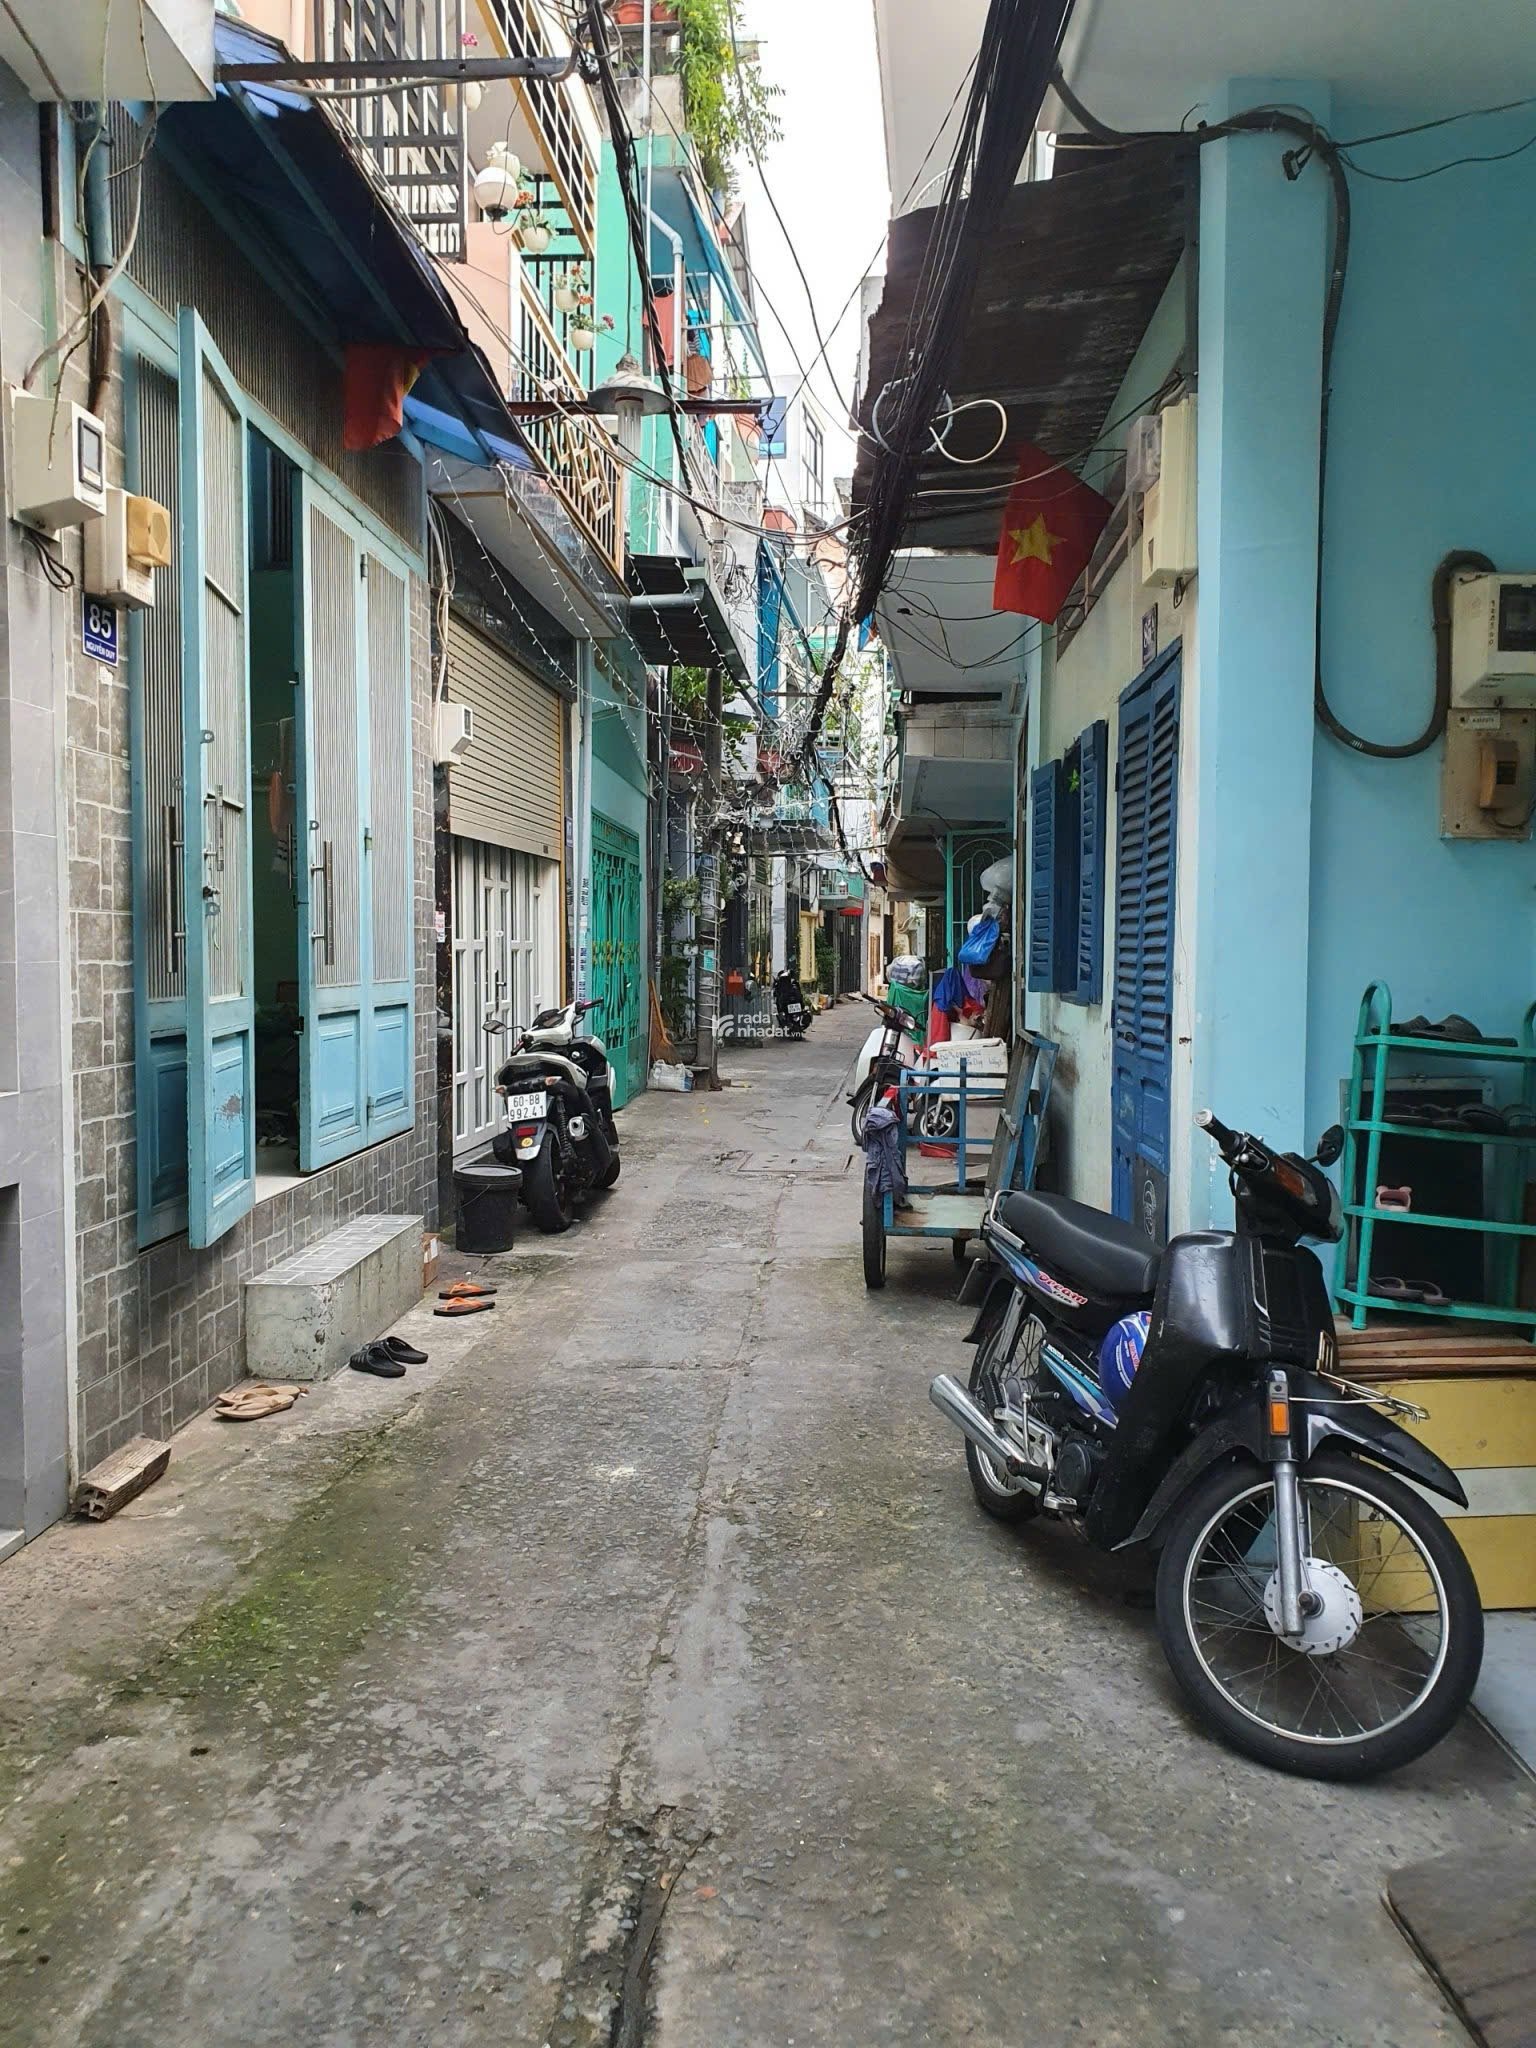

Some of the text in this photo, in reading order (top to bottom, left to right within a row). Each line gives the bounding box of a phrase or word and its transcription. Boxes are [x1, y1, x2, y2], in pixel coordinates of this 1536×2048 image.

[89, 604, 112, 639] 85
[509, 1105, 544, 1121] 992.41
[513, 1093, 540, 1108] 60-B8
[1038, 1269, 1088, 1305] Dream
